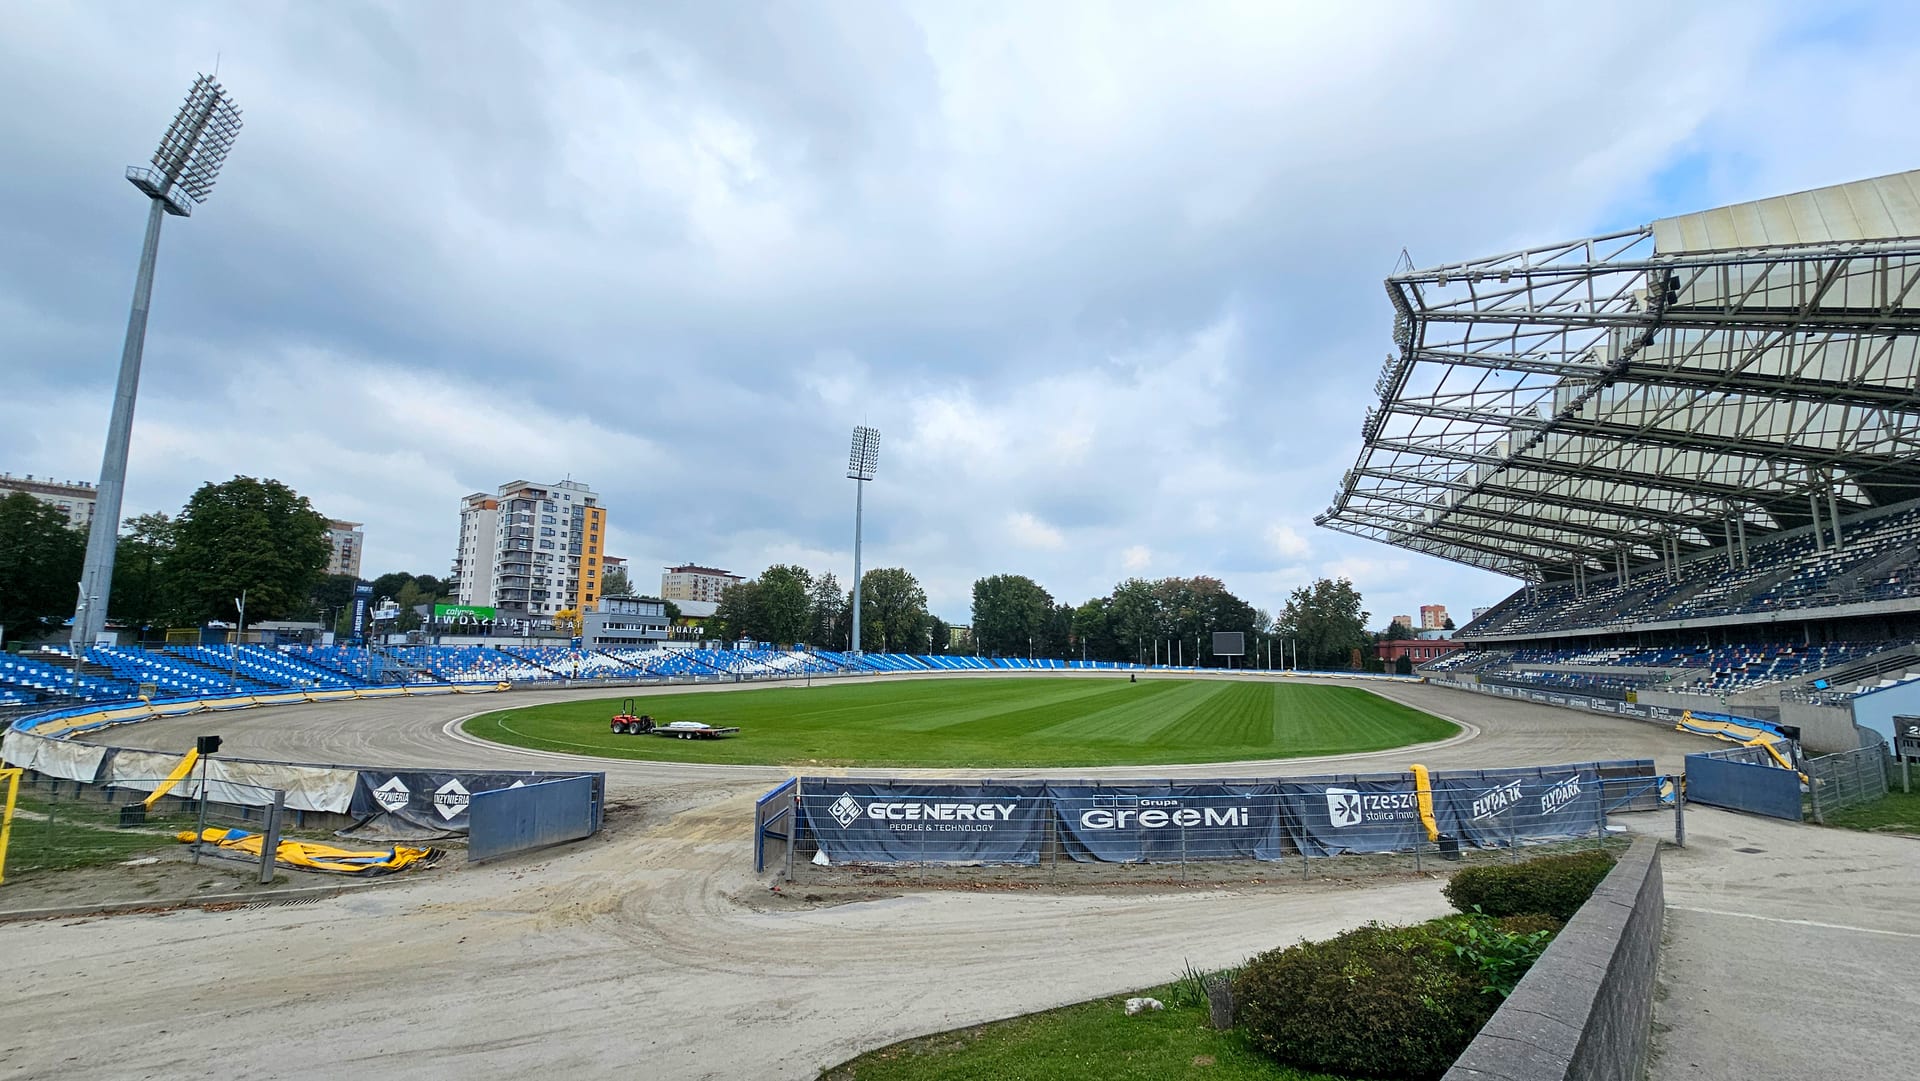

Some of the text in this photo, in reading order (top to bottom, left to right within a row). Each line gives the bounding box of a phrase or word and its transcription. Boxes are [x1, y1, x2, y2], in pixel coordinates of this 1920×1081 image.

[1541, 779, 1581, 811] FLYPARK
[1140, 799, 1178, 807] Grupa
[1366, 810, 1414, 820] stolica inno
[889, 823, 994, 832] PEOPLE & TECHNOLOGY
